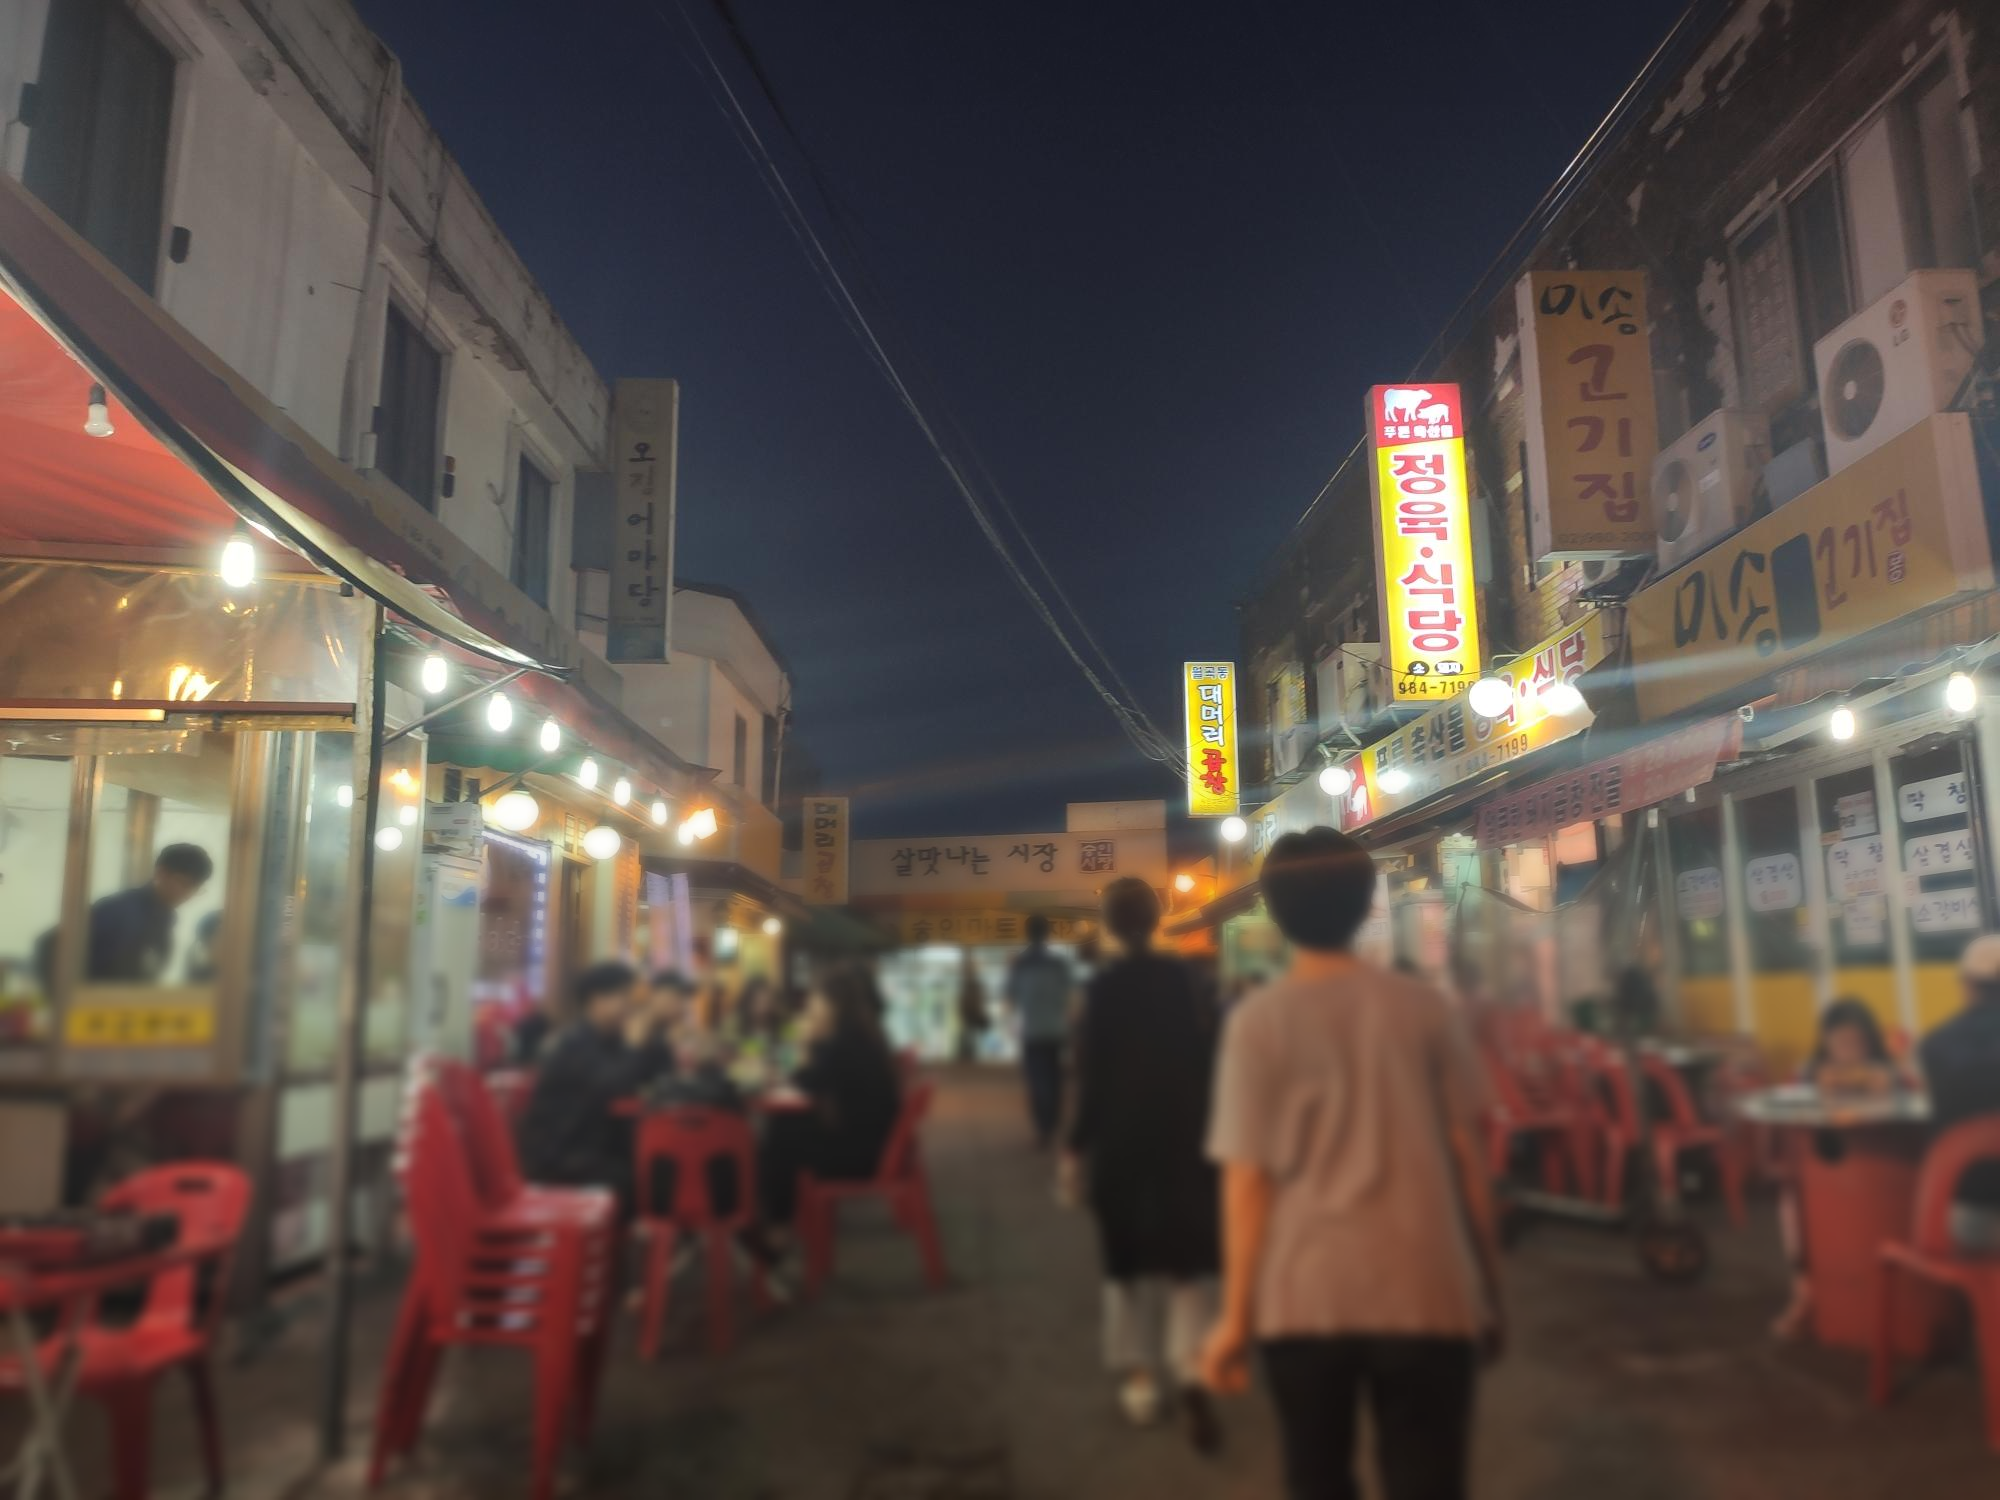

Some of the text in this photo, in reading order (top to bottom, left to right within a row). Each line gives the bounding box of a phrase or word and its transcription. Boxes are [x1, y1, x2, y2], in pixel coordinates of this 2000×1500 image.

[1540, 283, 1638, 335] 미송
[1567, 343, 1641, 523] 고기집
[1393, 454, 1462, 652] 정육·식당
[1674, 488, 1912, 658] 미송 고기집
[1398, 681, 1476, 695] 984-719
[890, 842, 1058, 878] 살맛나는 시장
[912, 917, 1019, 943] 숭인마트
